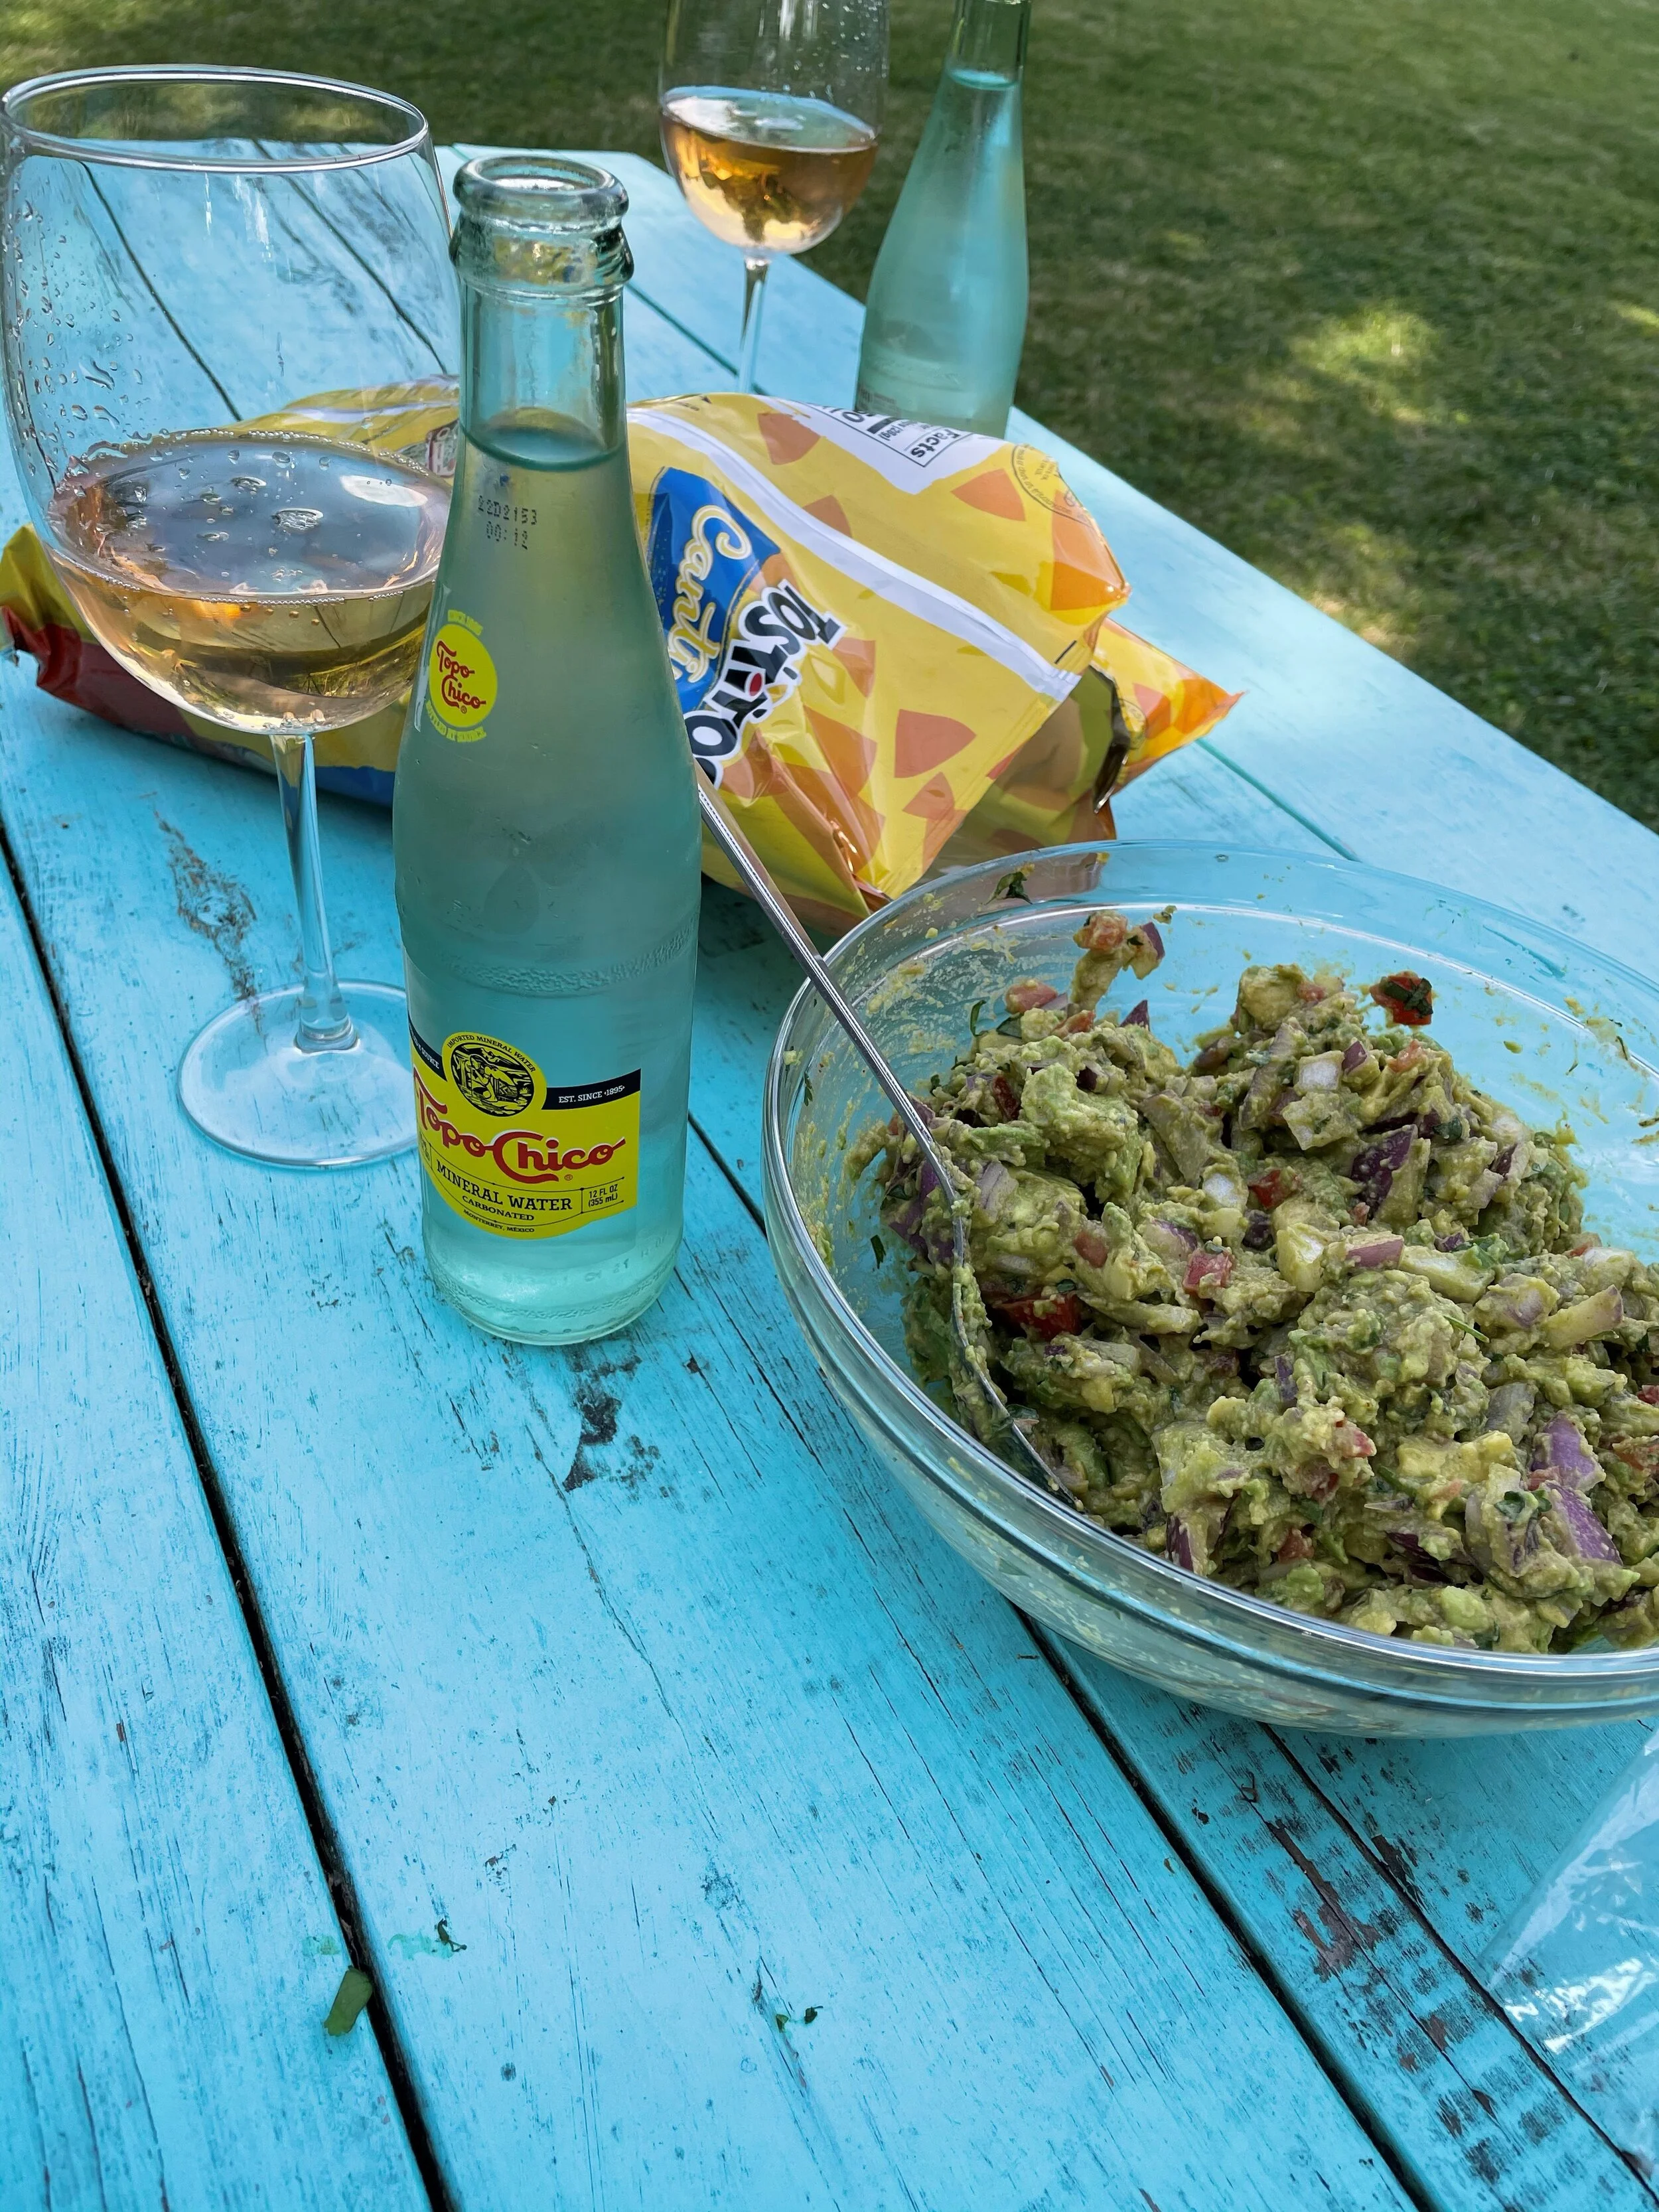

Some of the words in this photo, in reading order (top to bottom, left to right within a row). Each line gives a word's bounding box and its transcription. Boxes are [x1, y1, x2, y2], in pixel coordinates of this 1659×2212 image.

[911, 428, 961, 458] Facts
[667, 505, 753, 683] Canti
[437, 640, 475, 678] Topo
[441, 674, 486, 709] Chico
[447, 1035, 475, 1049] IMPORTED
[476, 1035, 512, 1054] MINERAL
[514, 1052, 536, 1073] WATER
[577, 1090, 603, 1102] SINCE
[607, 1085, 623, 1096] 1895
[413, 1065, 488, 1158] Topo
[490, 1130, 626, 1184] Chico
[436, 1159, 503, 1205] MINERAL
[507, 1195, 573, 1211] WATER
[588, 1197, 603, 1208] (355
[605, 1192, 618, 1203] mL)
[589, 1190, 597, 1199] 12
[609, 1183, 618, 1193] OZ
[462, 1195, 534, 1221] CARBONATED
[463, 1209, 505, 1231] MONTERREY,
